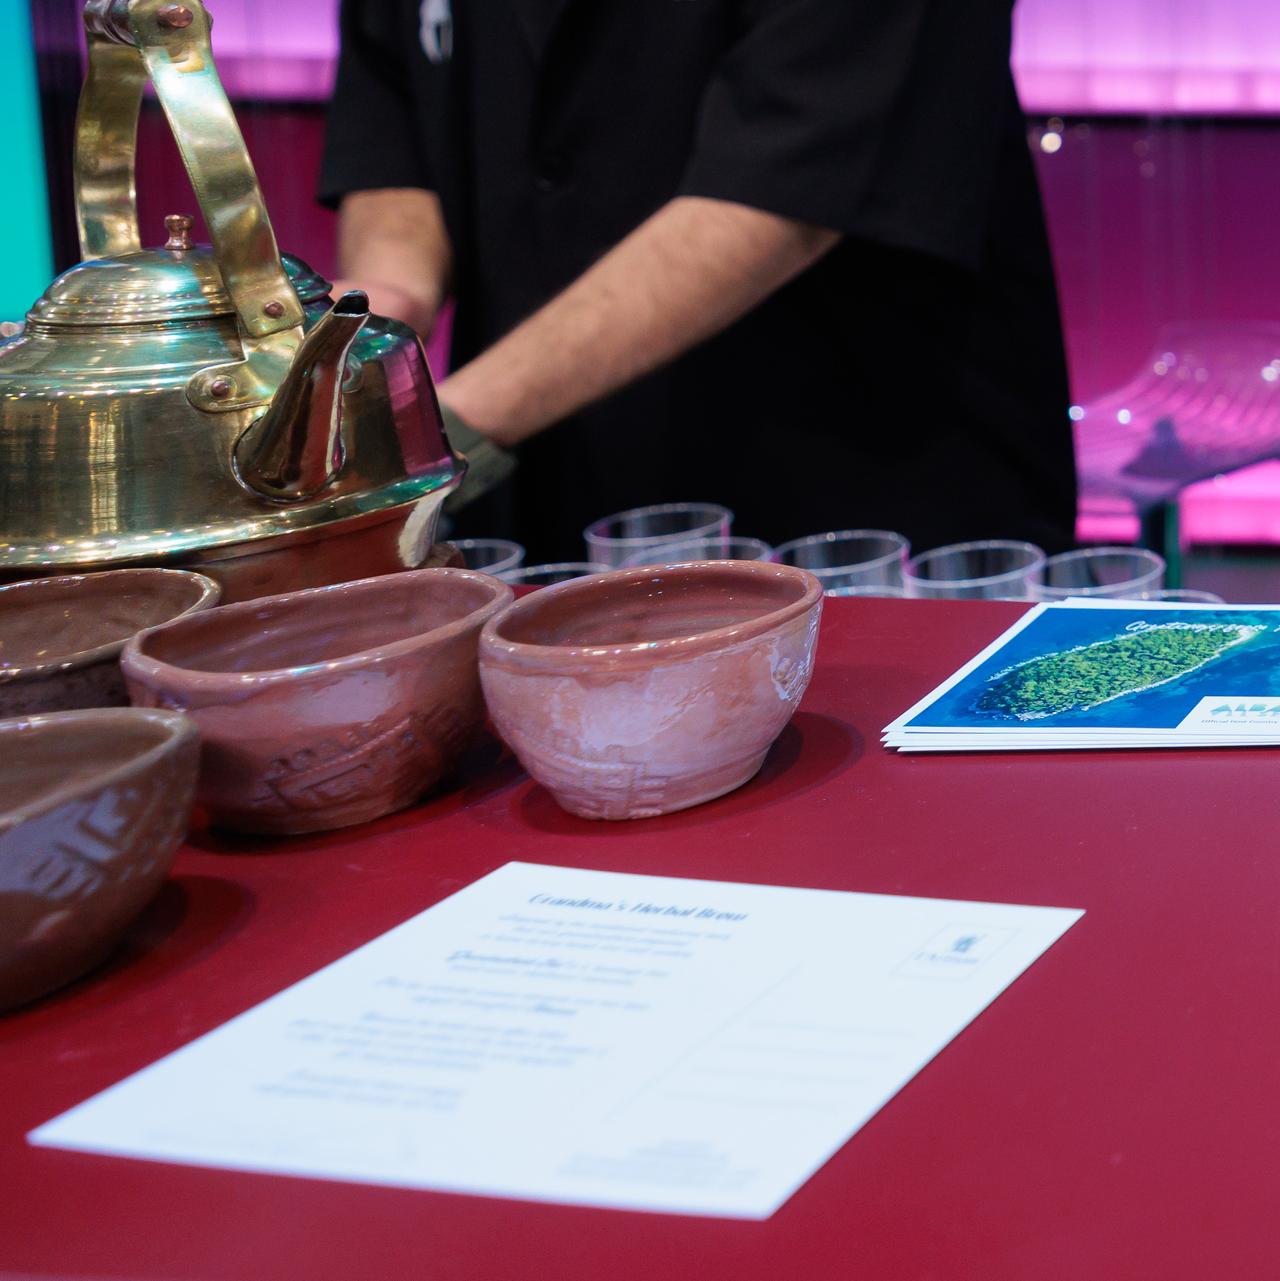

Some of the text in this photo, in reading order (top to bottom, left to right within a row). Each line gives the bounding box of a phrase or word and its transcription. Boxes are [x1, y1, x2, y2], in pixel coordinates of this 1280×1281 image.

[527, 893, 750, 923] Grandma's Herbal Brew
